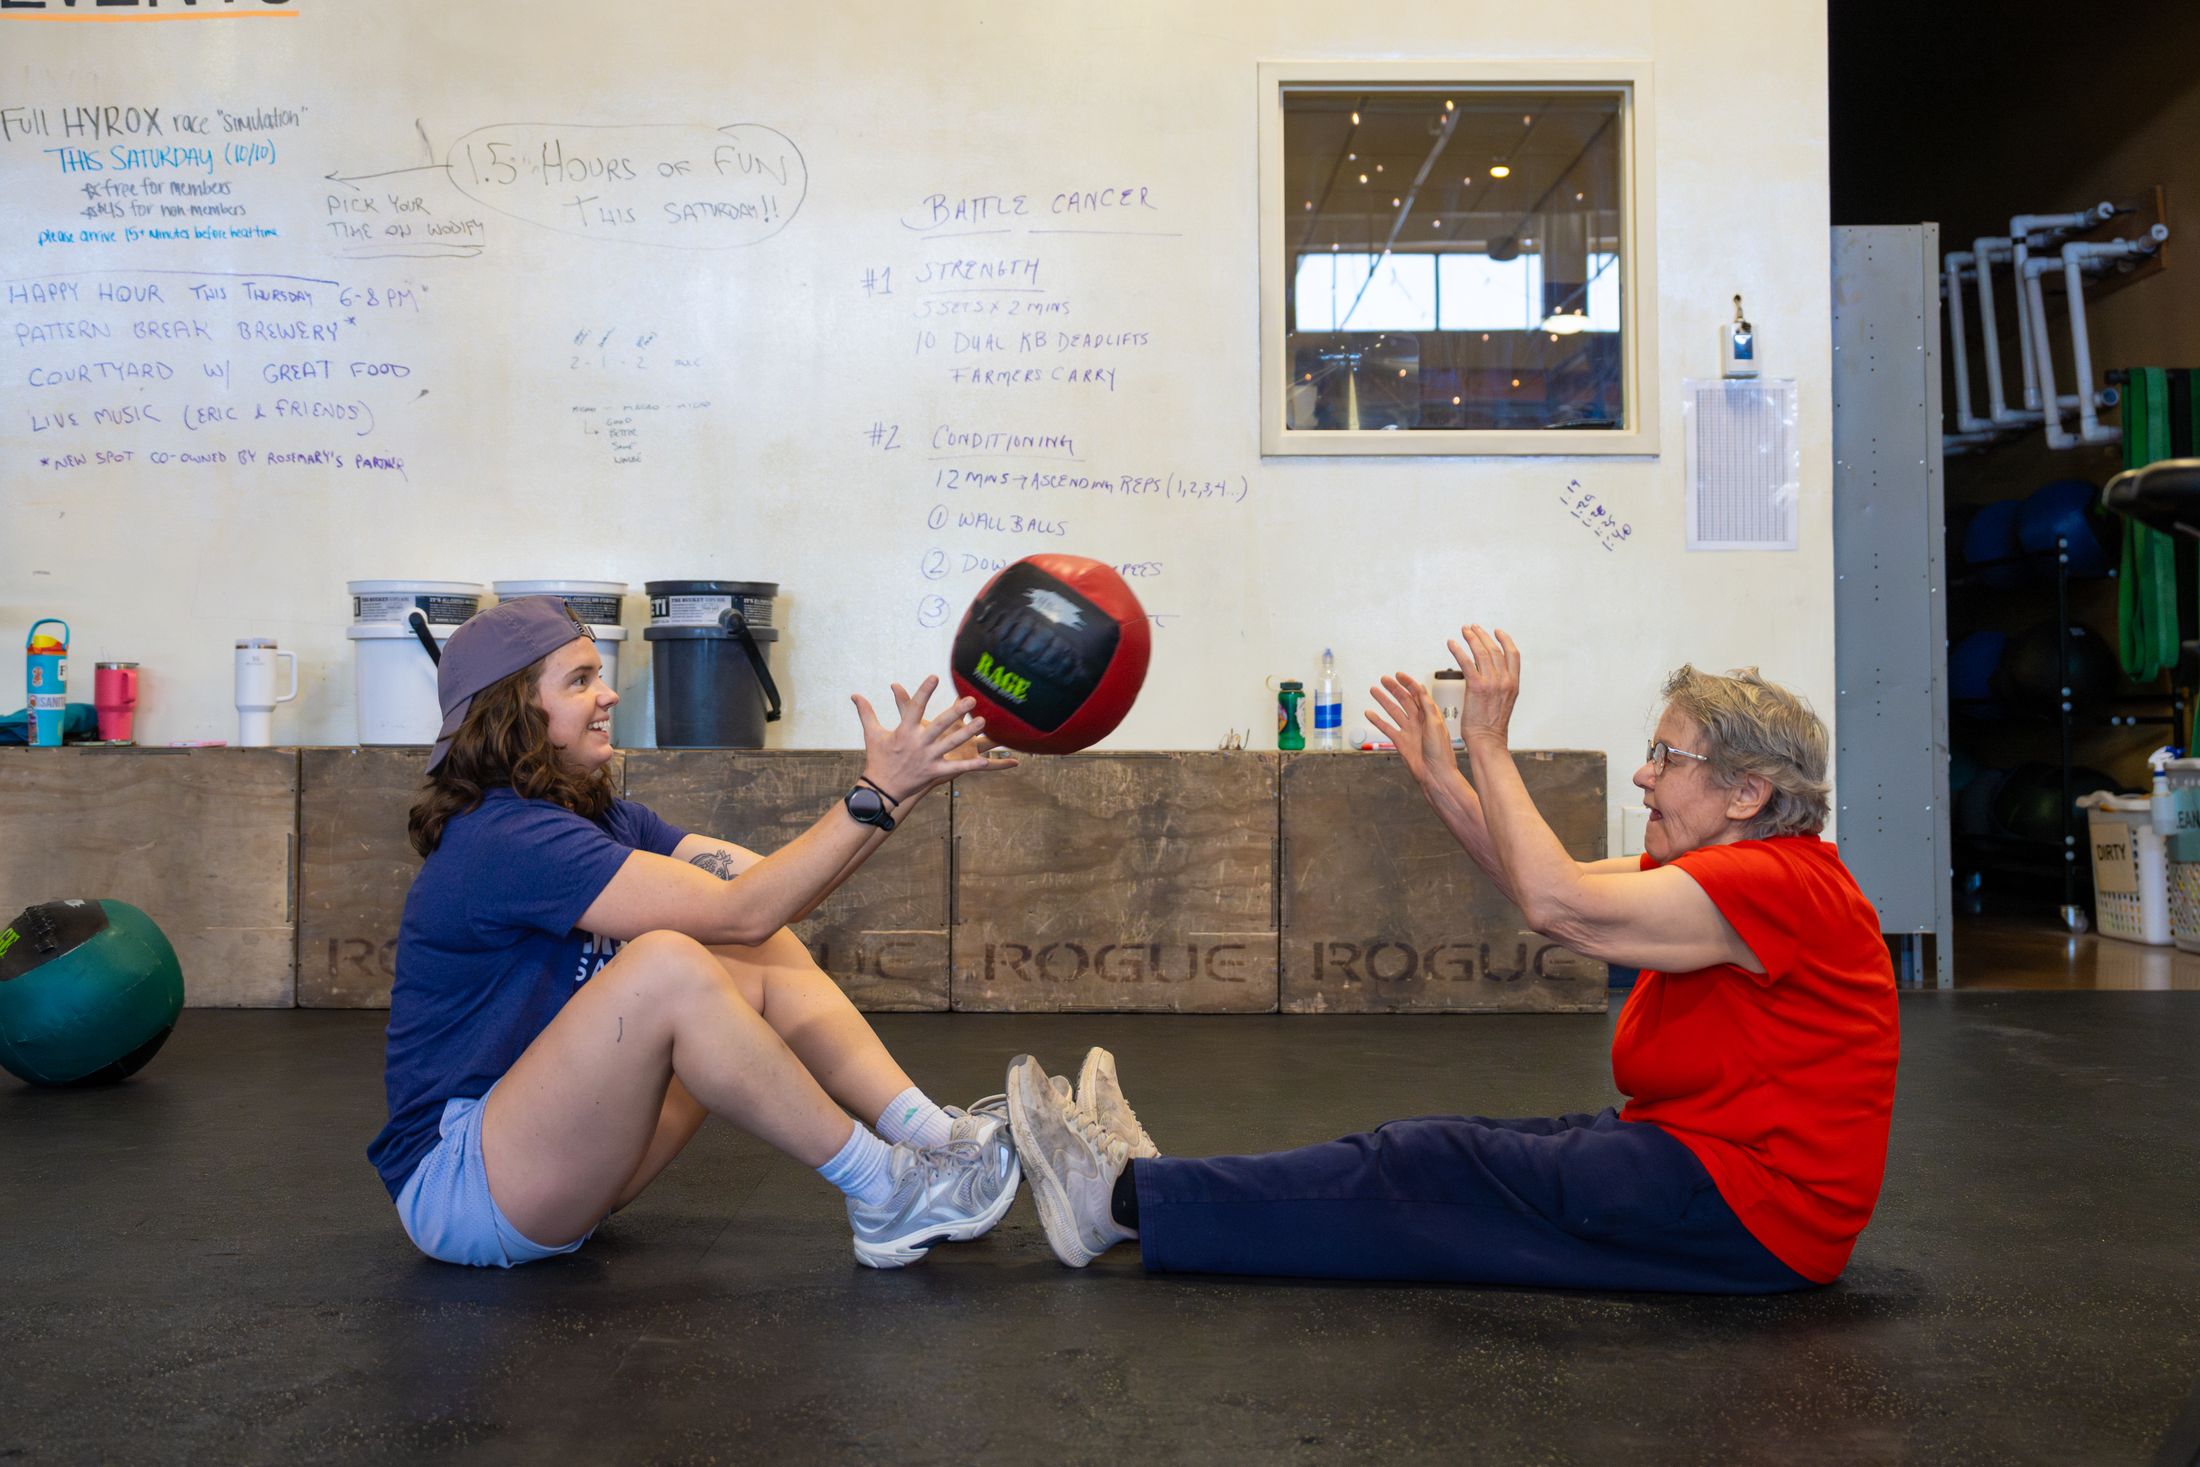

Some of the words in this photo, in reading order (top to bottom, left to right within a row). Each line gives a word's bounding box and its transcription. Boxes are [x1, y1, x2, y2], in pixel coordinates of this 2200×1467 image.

[0, 107, 49, 141] Full
[62, 106, 163, 140] HYROX
[173, 114, 210, 135] race
[43, 147, 103, 174] THIS
[111, 145, 214, 175] SATURDAY
[224, 139, 276, 166] (10/10)
[542, 139, 636, 187] HOURS
[658, 161, 691, 177] OF
[714, 145, 787, 186] FUN
[103, 179, 138, 198] free
[143, 177, 163, 195] for
[170, 179, 232, 196] members
[130, 200, 152, 217] for
[327, 196, 379, 214] PICK
[389, 196, 431, 214] YOUR
[564, 196, 636, 228] THIS
[664, 196, 777, 222] SATURDAY!!
[901, 193, 1029, 230] BATTLE
[1051, 187, 1158, 215] CANCER
[38, 226, 75, 246] please
[80, 229, 117, 243] arrive
[194, 225, 227, 240] before
[327, 222, 372, 239] TIME
[385, 223, 411, 238] ON
[861, 267, 893, 297] #1
[915, 258, 1040, 284] STRENGTH
[9, 282, 80, 304] HAPPY
[100, 282, 163, 303] HOUR
[190, 285, 227, 300] THIS
[242, 282, 313, 306] THURSDAY
[936, 300, 983, 316] SETS
[1008, 300, 1020, 315] 2
[1027, 301, 1071, 316] MINS
[16, 321, 111, 346] PATTERN
[133, 319, 211, 340] BREAK
[915, 331, 936, 354] 10
[954, 331, 1006, 353] DUAL
[1019, 331, 1047, 352] KB
[1058, 331, 1149, 351] DEADLIFTS
[29, 361, 173, 387] COURTYARD
[204, 360, 230, 389] W/
[263, 360, 334, 384] GREAT
[350, 363, 410, 378] FOOD
[950, 368, 1041, 386] FARMERS
[1051, 367, 1117, 391] CARRY
[31, 412, 79, 432] LIVE
[93, 404, 161, 424] MUSIC
[184, 403, 238, 431] (ERIC
[276, 400, 375, 436] FRIENDS)
[864, 422, 901, 450] #2
[932, 425, 1074, 456] CONDITIONING
[96, 451, 135, 465] SPOT
[150, 452, 227, 464] CO-OWNED
[238, 451, 257, 465] BY
[936, 469, 960, 489] 12
[964, 470, 1009, 486] MINS
[1031, 472, 1113, 495] ASCENDING
[1120, 475, 1161, 495] REPS
[959, 513, 1006, 532] WALL
[1010, 513, 1069, 536] BALLS
[962, 553, 1006, 573] DOW
[976, 651, 1031, 700] RAGE
[2097, 844, 2127, 861] DIRTY
[984, 943, 1246, 983] ROGUE
[1312, 942, 1577, 982] ROGUE
